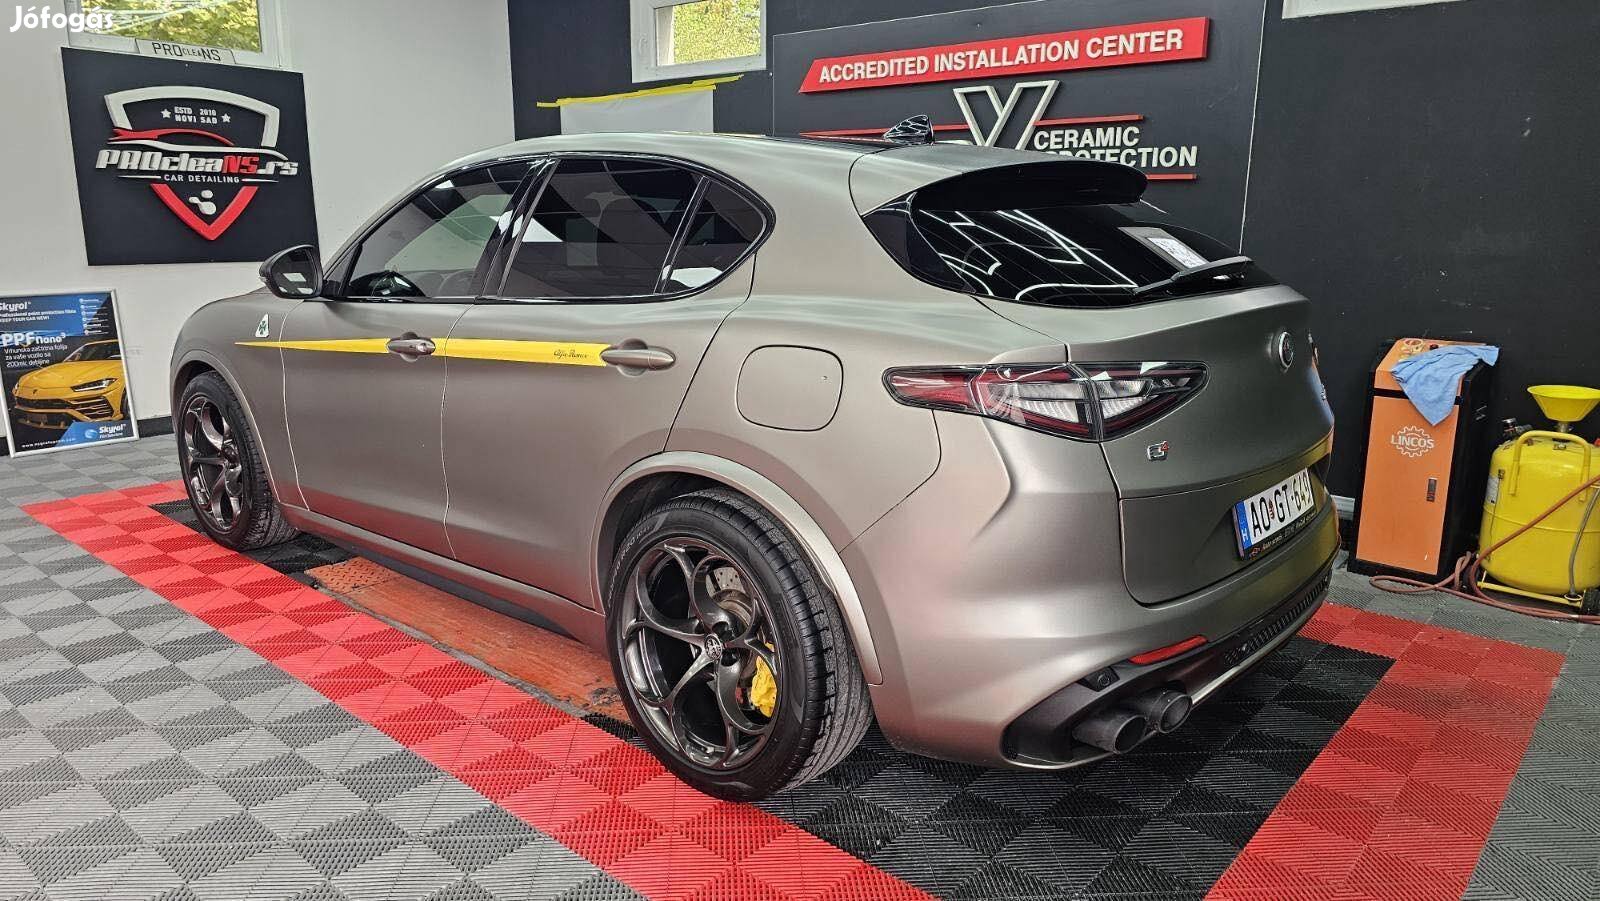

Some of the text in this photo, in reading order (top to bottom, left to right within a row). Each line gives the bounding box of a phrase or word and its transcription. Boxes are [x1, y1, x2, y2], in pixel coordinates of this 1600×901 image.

[818, 29, 1184, 84] ACCREDITED INSTALLATION CENTER
[174, 114, 218, 125] NOVI SAD
[1033, 126, 1140, 151] CERAMIC
[1045, 145, 1198, 168] TECTION
[164, 173, 240, 184] CAR DETAILING
[1391, 434, 1434, 448] LINCOS
[1250, 496, 1272, 538] AO
[1274, 471, 1312, 523] GT-649
